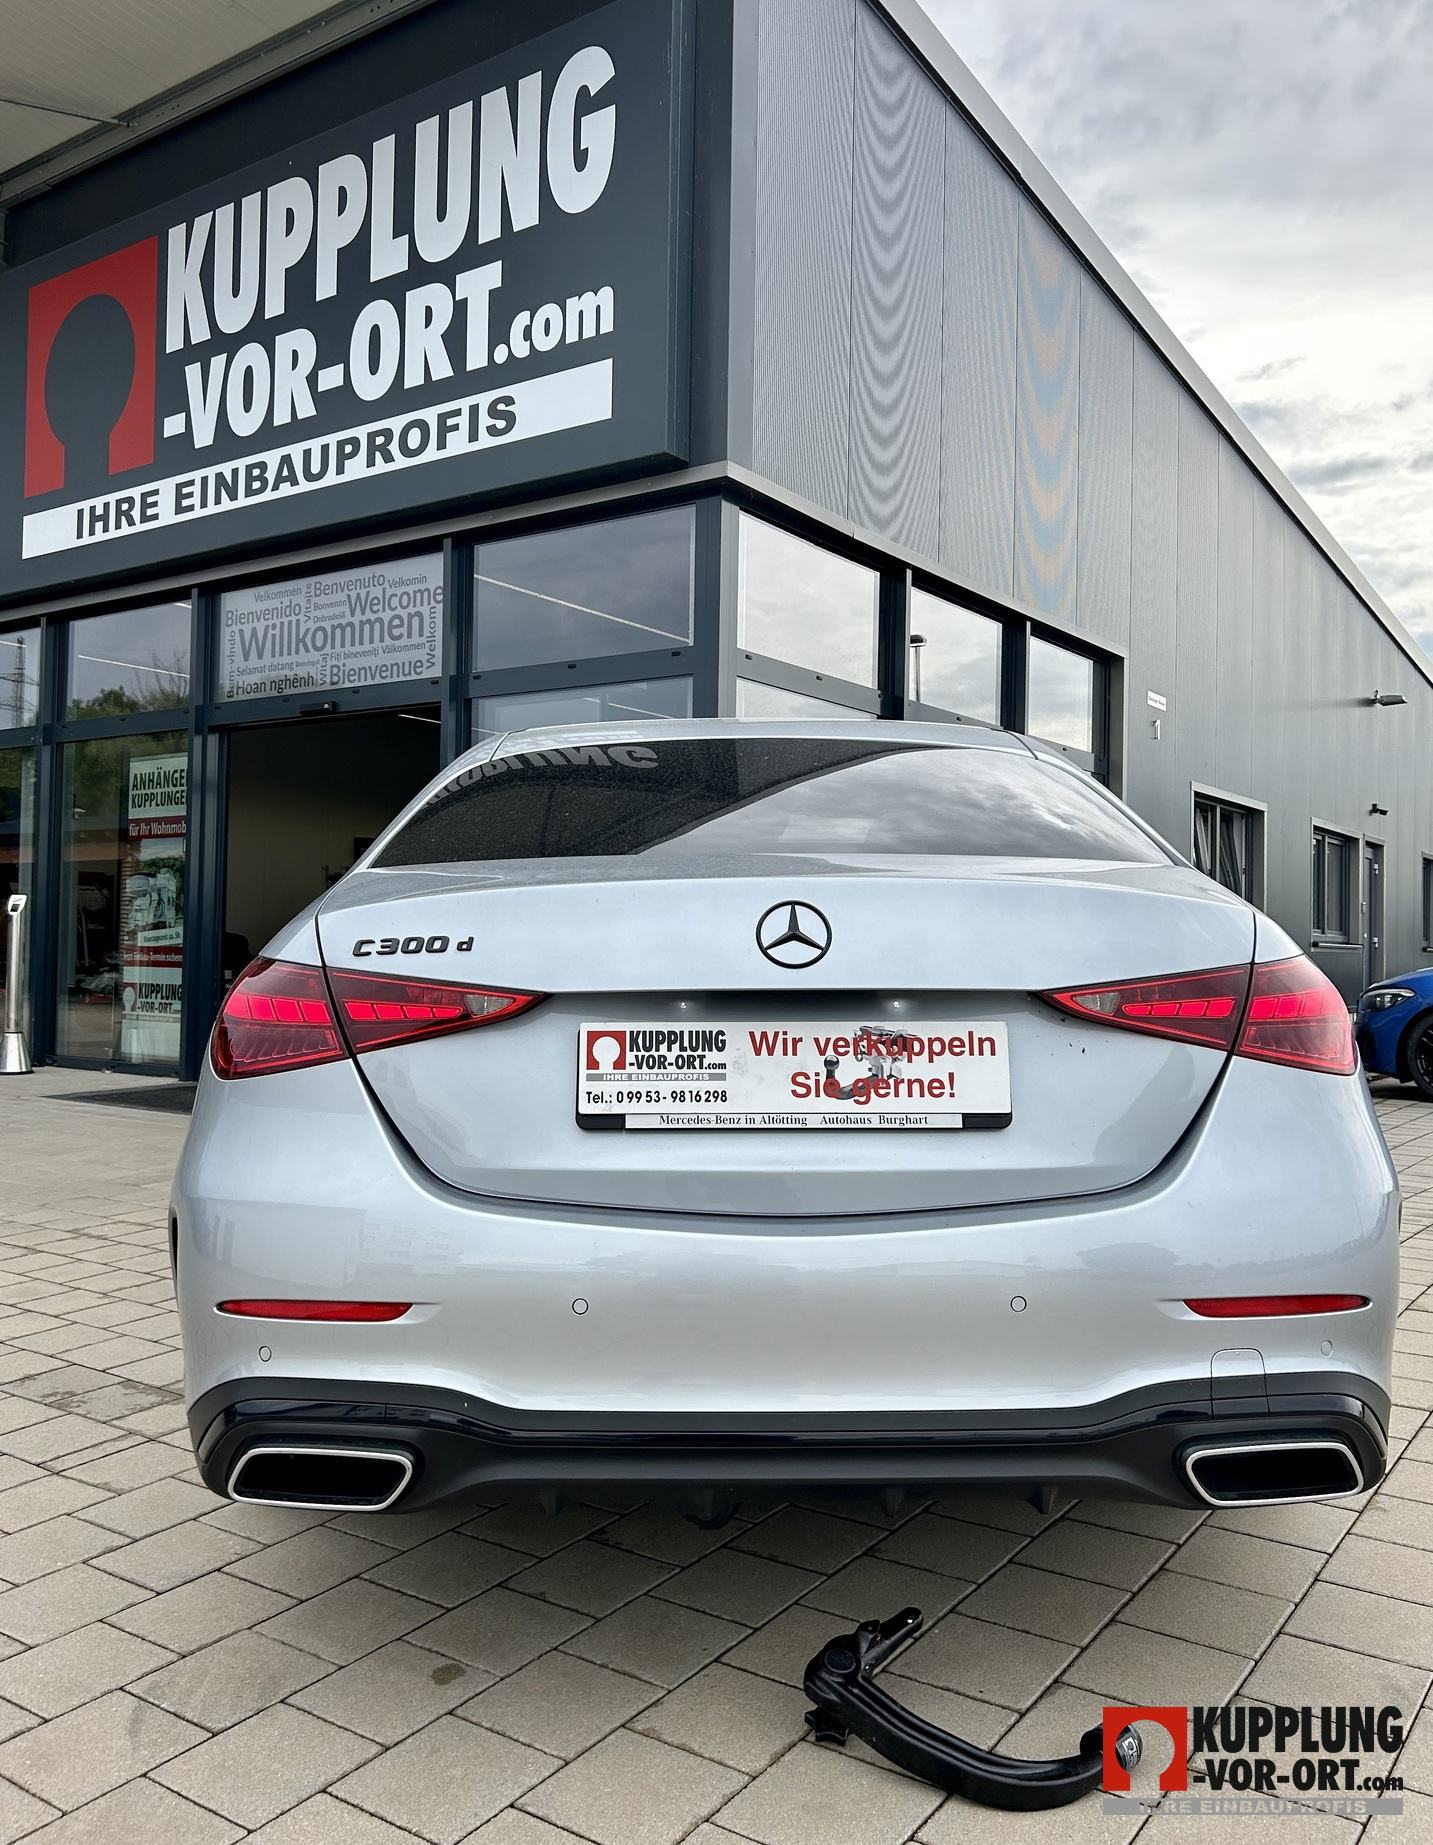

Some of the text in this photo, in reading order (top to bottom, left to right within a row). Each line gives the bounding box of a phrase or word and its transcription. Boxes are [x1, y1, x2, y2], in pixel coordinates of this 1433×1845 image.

[165, 45, 617, 354] KUPPLUNG
[163, 260, 614, 449] -VOR-ORT.com
[75, 395, 517, 540] IHRE EINBAUPROFIS
[314, 572, 385, 597] Benvenuto
[388, 574, 427, 589] Velkomin
[254, 587, 302, 602] Velkommen
[304, 582, 313, 623] Vitajte
[313, 599, 347, 611] Bonvenon
[346, 585, 443, 617] Welcome
[226, 599, 302, 627] Bienvenido
[238, 610, 424, 662] Willkommen
[381, 641, 426, 654] Välkommen
[426, 606, 437, 670] Welkom
[227, 630, 236, 698] Bem-vindo
[236, 661, 294, 677] Selamat datang
[329, 659, 424, 686] Bienvenue
[236, 680, 267, 696] Hoan
[270, 671, 314, 693] nghênh
[131, 790, 187, 809] KUPPLUNGE
[129, 823, 139, 836] für
[140, 822, 150, 835] Ihr
[352, 935, 475, 957] C300 d
[138, 982, 182, 1001] KUPPLUNG
[629, 1030, 726, 1053] KUPPLUNG
[748, 1030, 997, 1063] Wir verkuppeln
[629, 1055, 727, 1070] -VOR-ORT.com
[603, 1073, 710, 1081] IHRE EINBAUPROFIS
[790, 1071, 956, 1106] Sie gerne!
[586, 1091, 612, 1104] Tel.:
[659, 1114, 928, 1127] Mercedes-Benz in Altötting Autohaus Burghart
